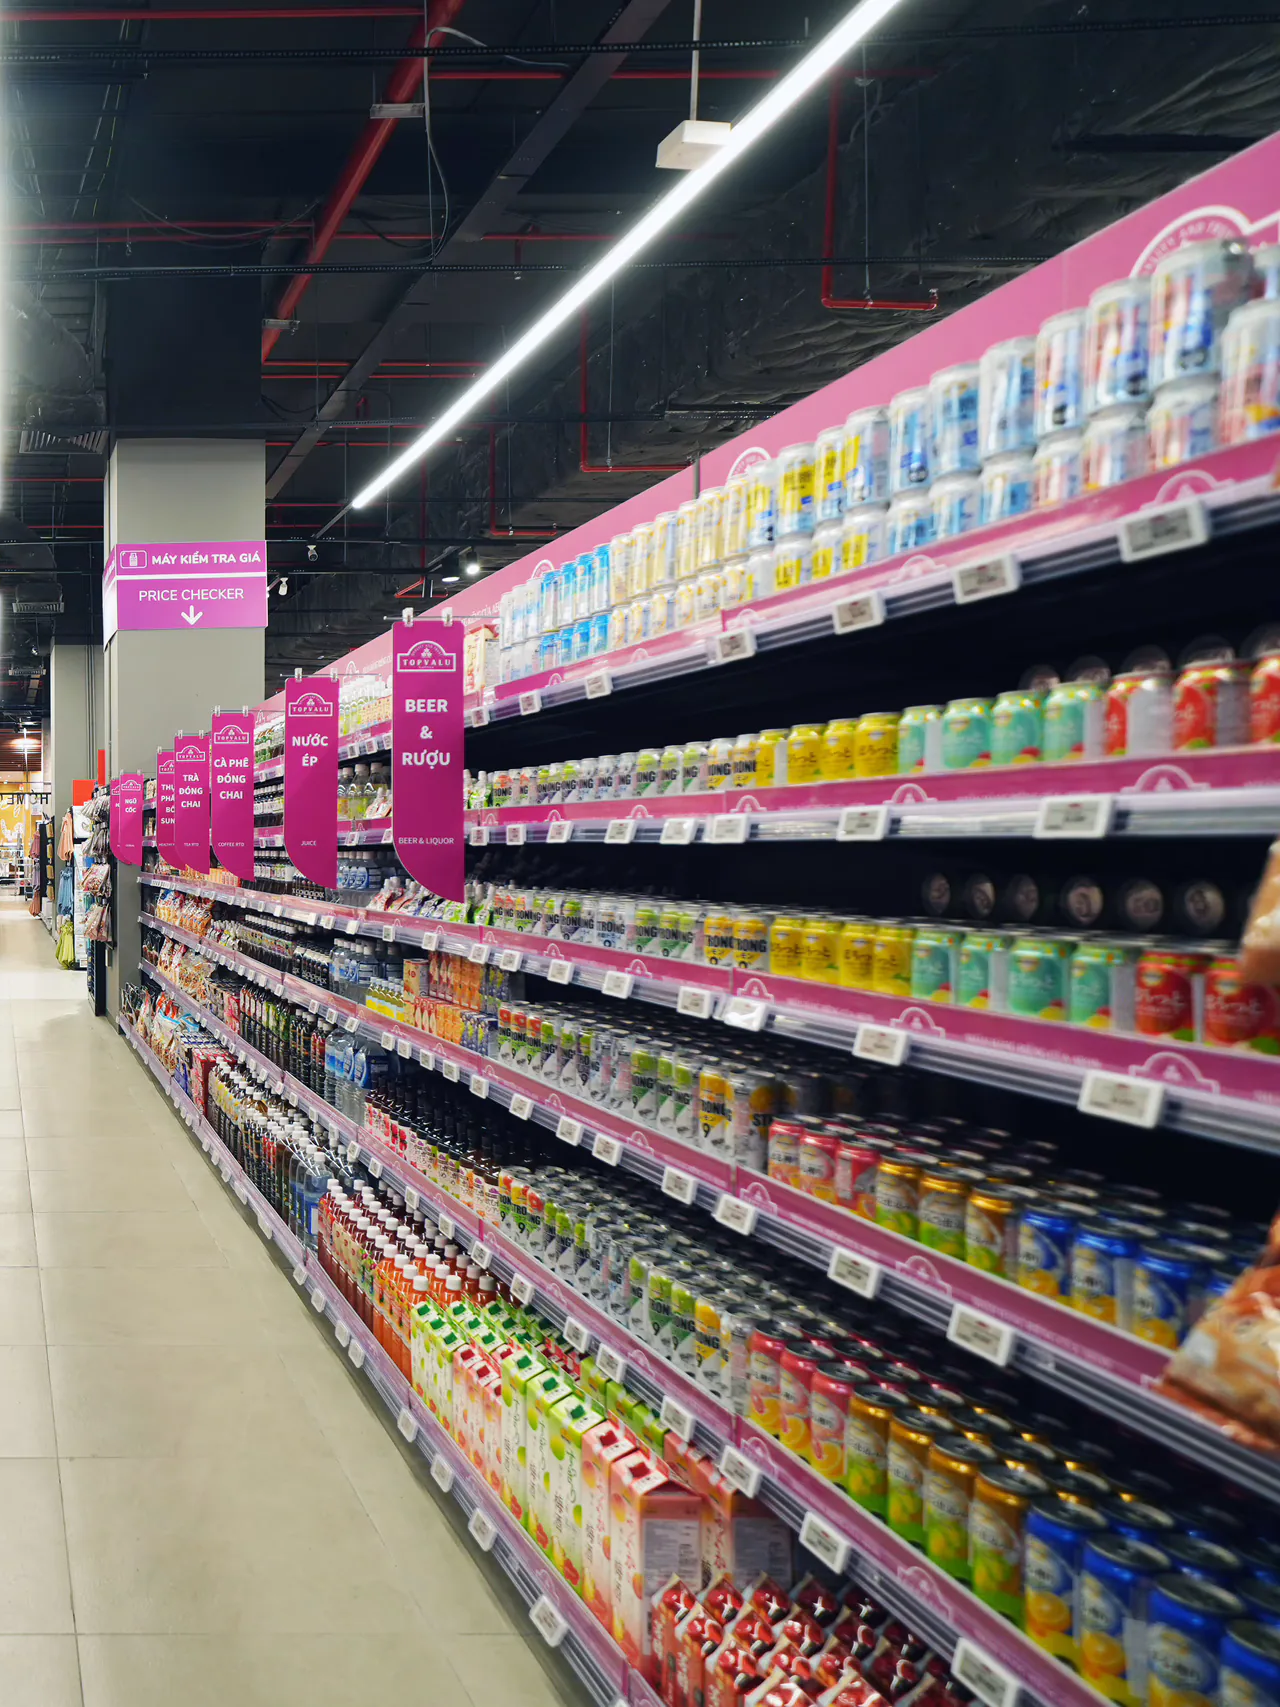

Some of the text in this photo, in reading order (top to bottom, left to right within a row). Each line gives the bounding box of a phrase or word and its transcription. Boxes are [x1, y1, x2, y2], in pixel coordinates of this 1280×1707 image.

[151, 550, 262, 565] MÁY KIỂM TRA GIÁ
[139, 588, 244, 602] PRICE CHECKER
[402, 658, 451, 667] TOPVALU
[405, 699, 448, 713] BEER
[420, 725, 433, 740] &
[292, 733, 329, 747] NƯỚC
[214, 757, 249, 768] CÀ PHÊ
[302, 753, 318, 767] ÉP
[402, 749, 451, 770] RƯỢU
[183, 772, 200, 782] TRÀ
[217, 773, 246, 784] ĐÓNG
[179, 785, 203, 795] ĐÓNG
[219, 790, 243, 799] CHAI
[181, 800, 201, 809] CHAI
[398, 837, 455, 846] BEER & LIQUOR
